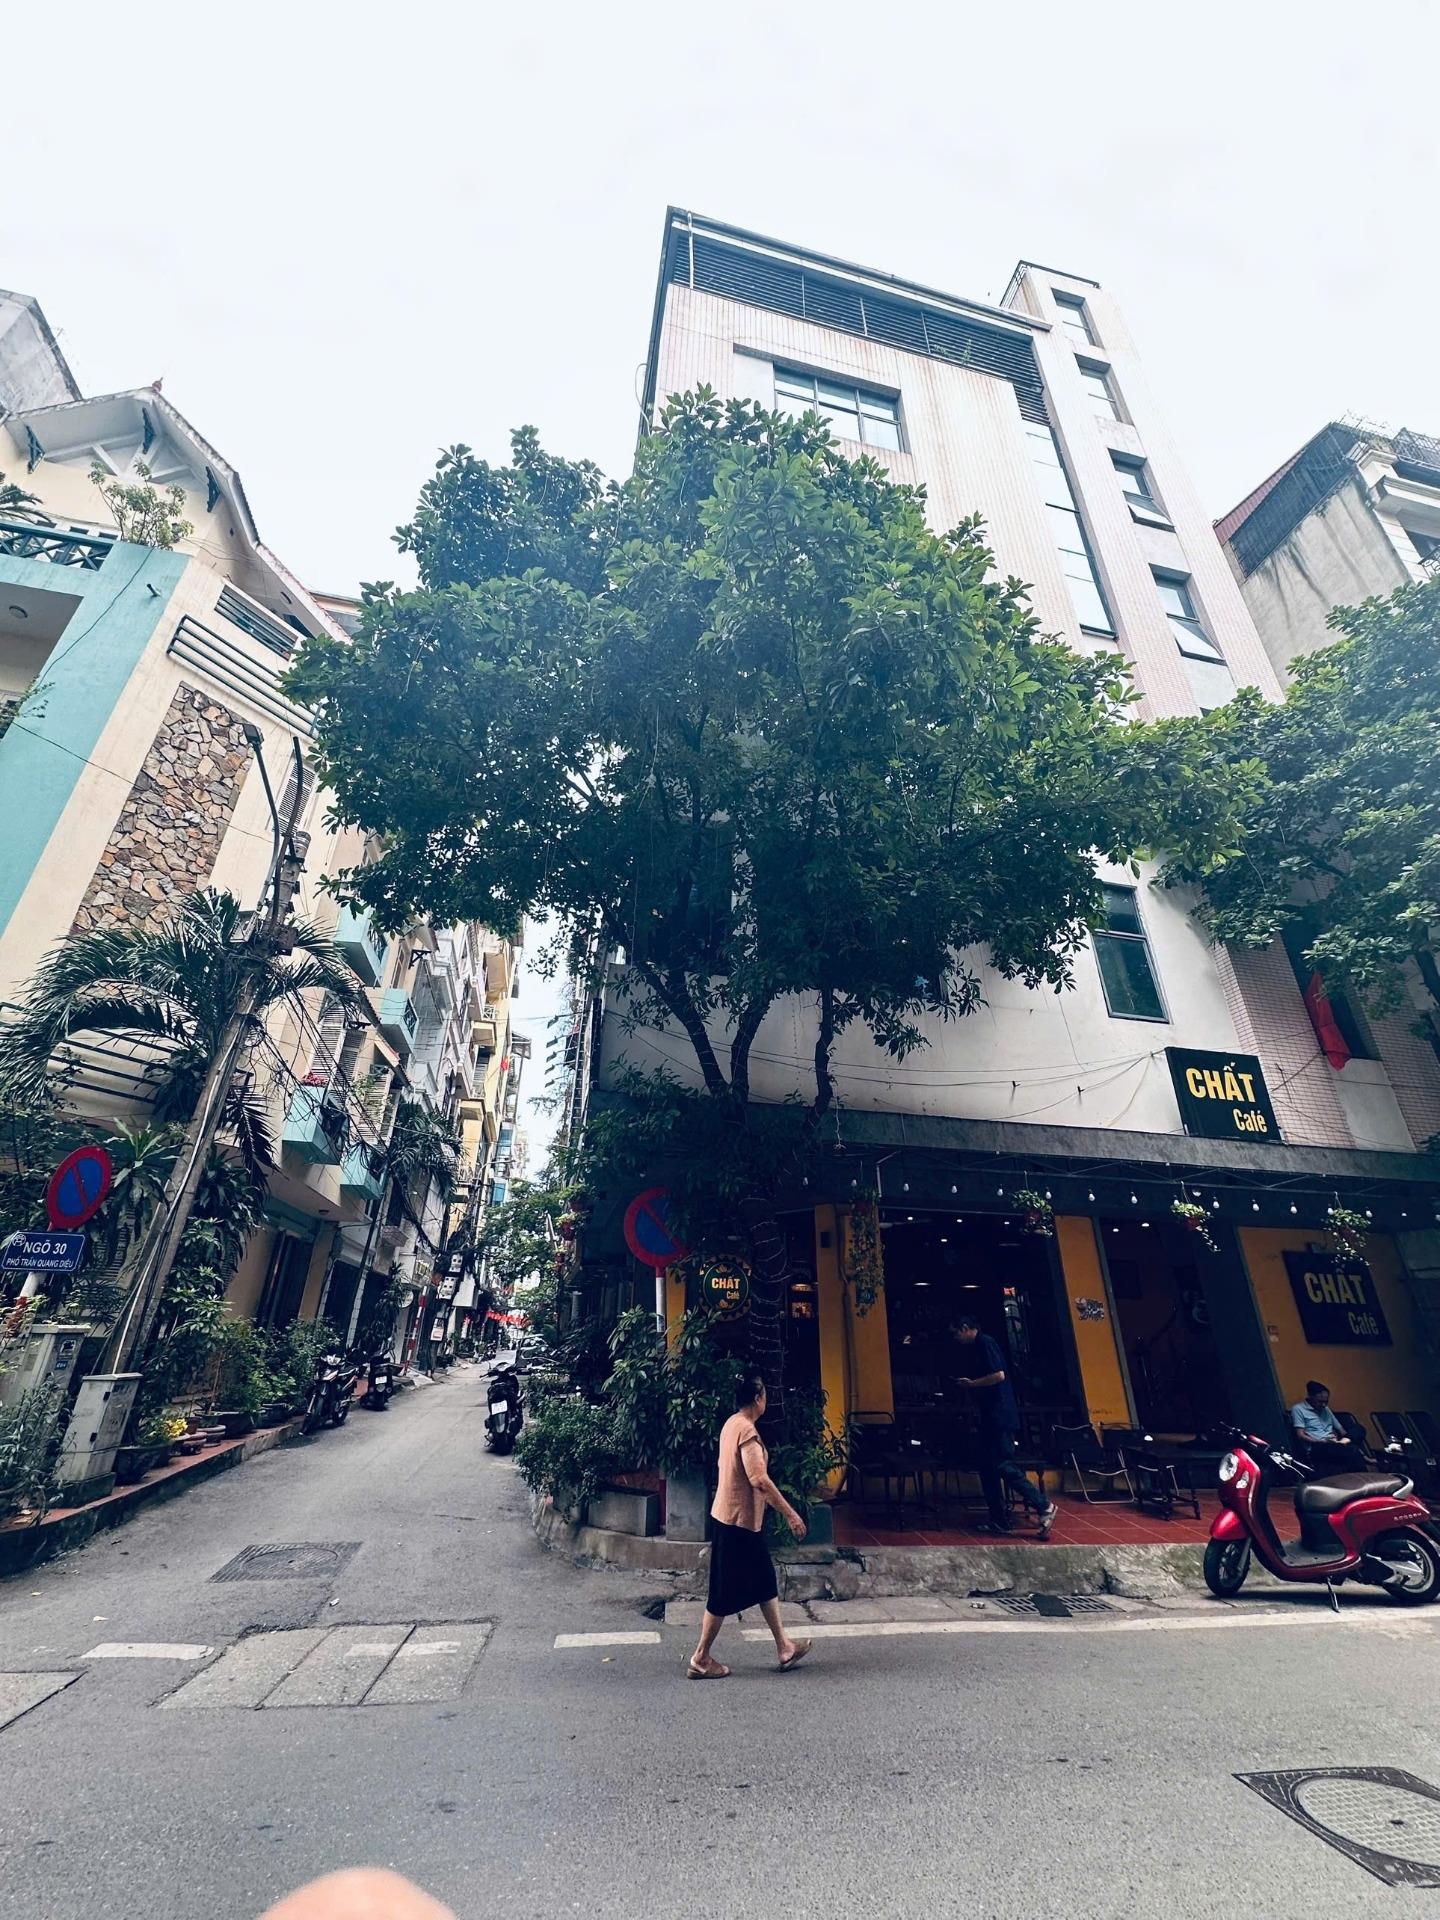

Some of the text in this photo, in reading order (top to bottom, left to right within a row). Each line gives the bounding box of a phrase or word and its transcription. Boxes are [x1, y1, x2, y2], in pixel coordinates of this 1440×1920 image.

[1185, 1062, 1256, 1102] CHẤT
[1232, 1108, 1268, 1133] Café
[22, 1240, 67, 1255] NGÕ 30
[37, 1259, 59, 1268] QUANG
[711, 1275, 741, 1289] CHẤT
[1303, 1264, 1367, 1304] CHẤT
[726, 1291, 740, 1300] Café
[1347, 1312, 1379, 1335] Café
